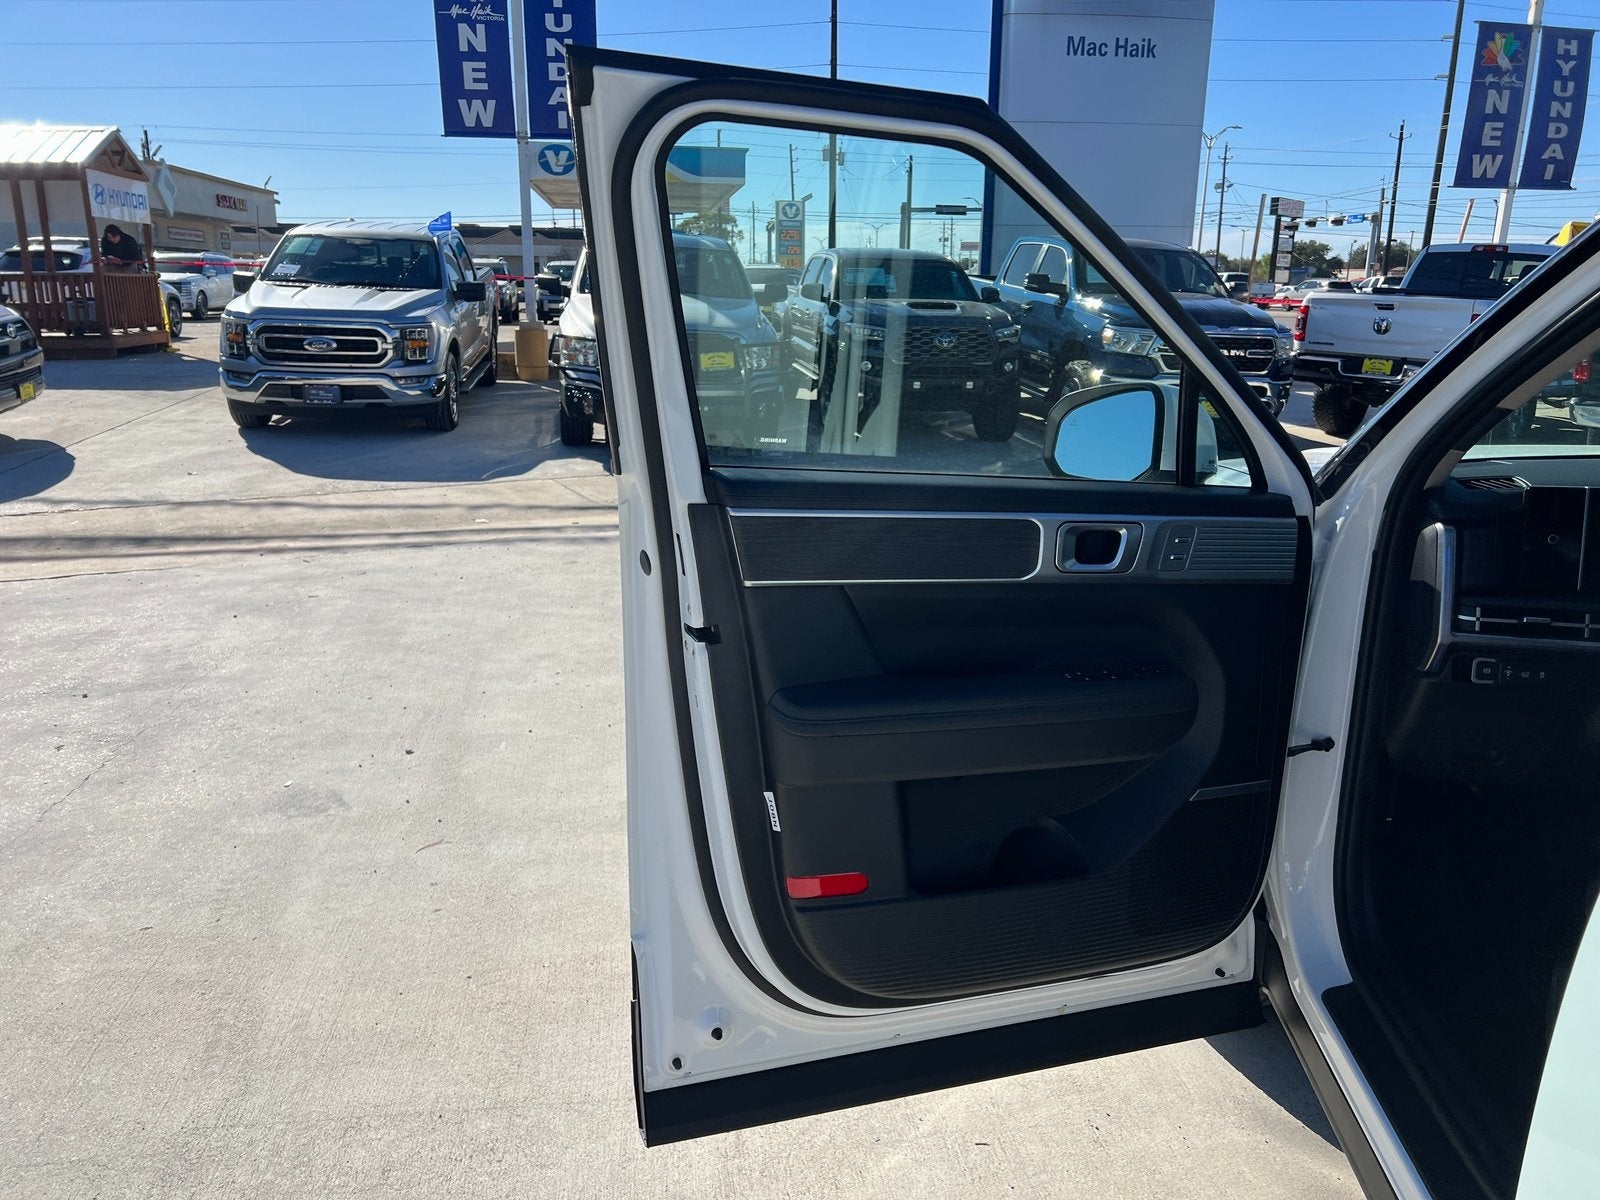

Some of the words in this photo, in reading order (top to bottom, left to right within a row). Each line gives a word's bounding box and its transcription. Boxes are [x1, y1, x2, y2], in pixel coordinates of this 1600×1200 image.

[444, 4, 470, 19] Mac
[470, 3, 499, 19] Haik
[544, 0, 573, 129] UNDAI
[1066, 35, 1108, 57] Mac
[1114, 37, 1157, 58] Haik
[457, 23, 496, 128] NEW
[1472, 90, 1510, 178] NEW
[1541, 39, 1578, 180] HYUNDAI
[107, 189, 147, 210] HYUNDAI
[311, 341, 328, 349] Ford
